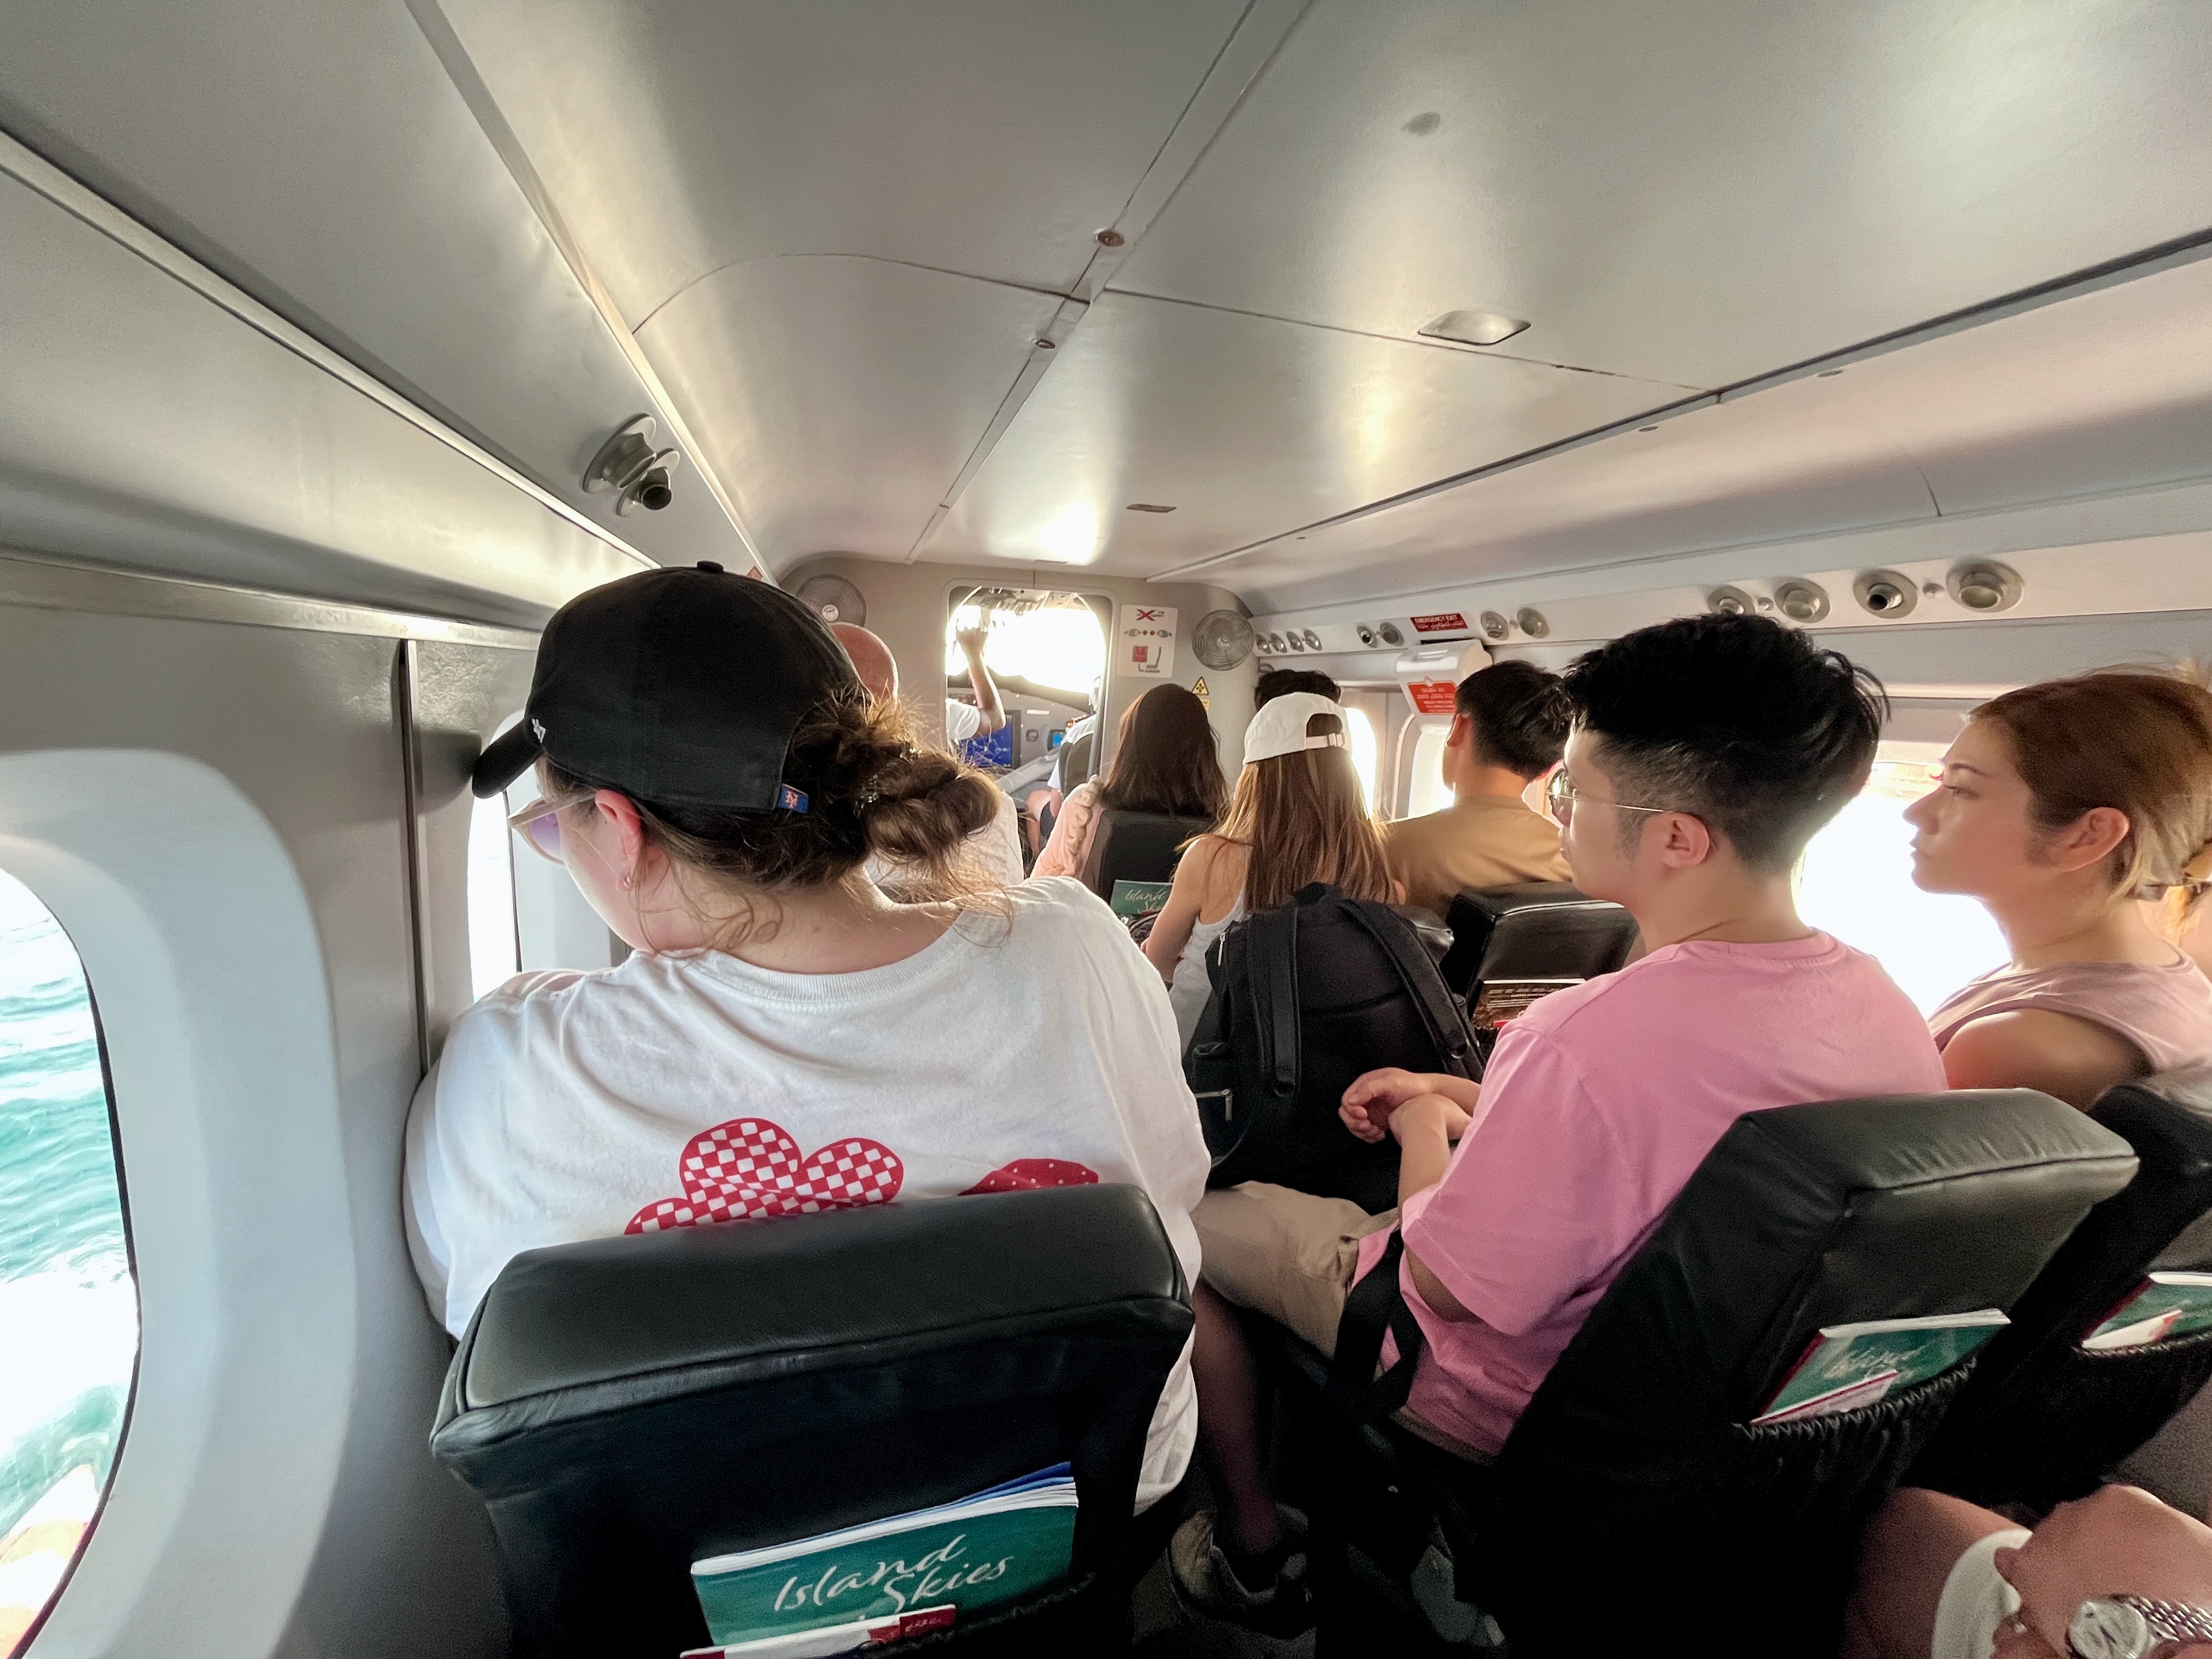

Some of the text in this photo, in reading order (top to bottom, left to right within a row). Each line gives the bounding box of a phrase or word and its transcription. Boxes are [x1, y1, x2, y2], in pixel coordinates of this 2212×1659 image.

[1125, 885, 1167, 902] Island
[774, 1534, 966, 1612] Island
[883, 1555, 1014, 1614] Skies
